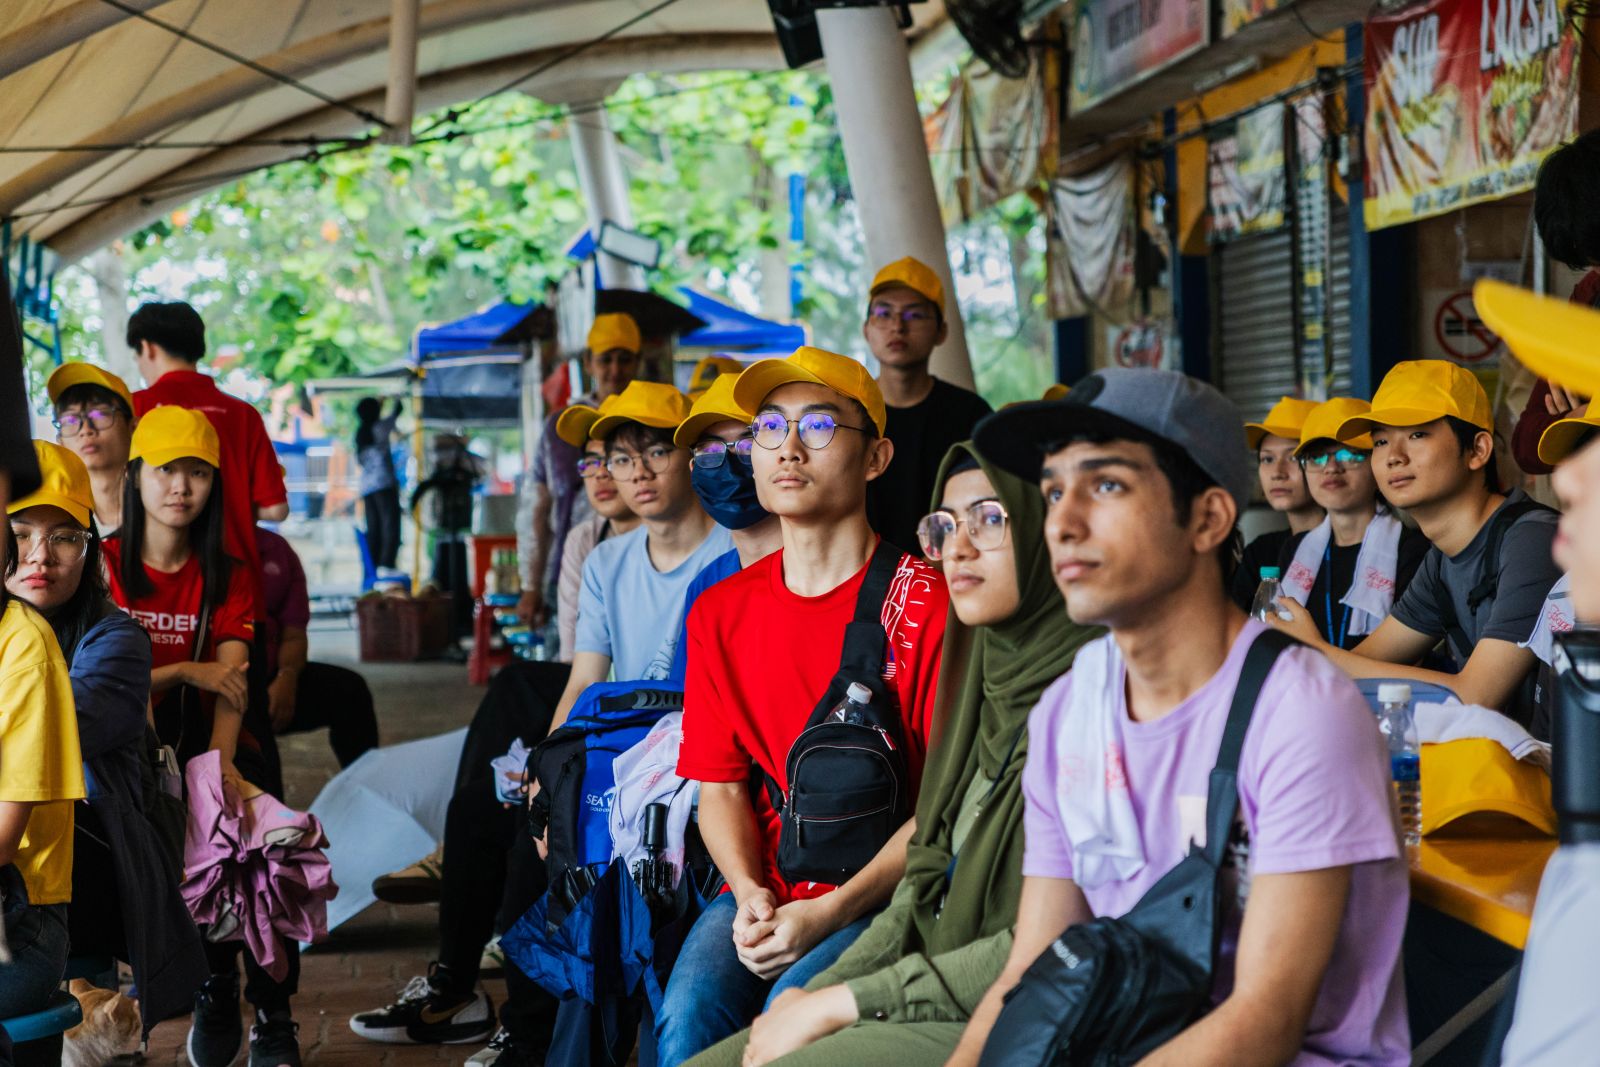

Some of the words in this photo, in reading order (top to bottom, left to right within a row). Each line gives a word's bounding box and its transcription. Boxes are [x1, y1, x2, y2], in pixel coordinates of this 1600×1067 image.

[1392, 14, 1438, 106] SUP
[1480, 0, 1558, 69] LAKSA
[586, 794, 604, 807] SEA
